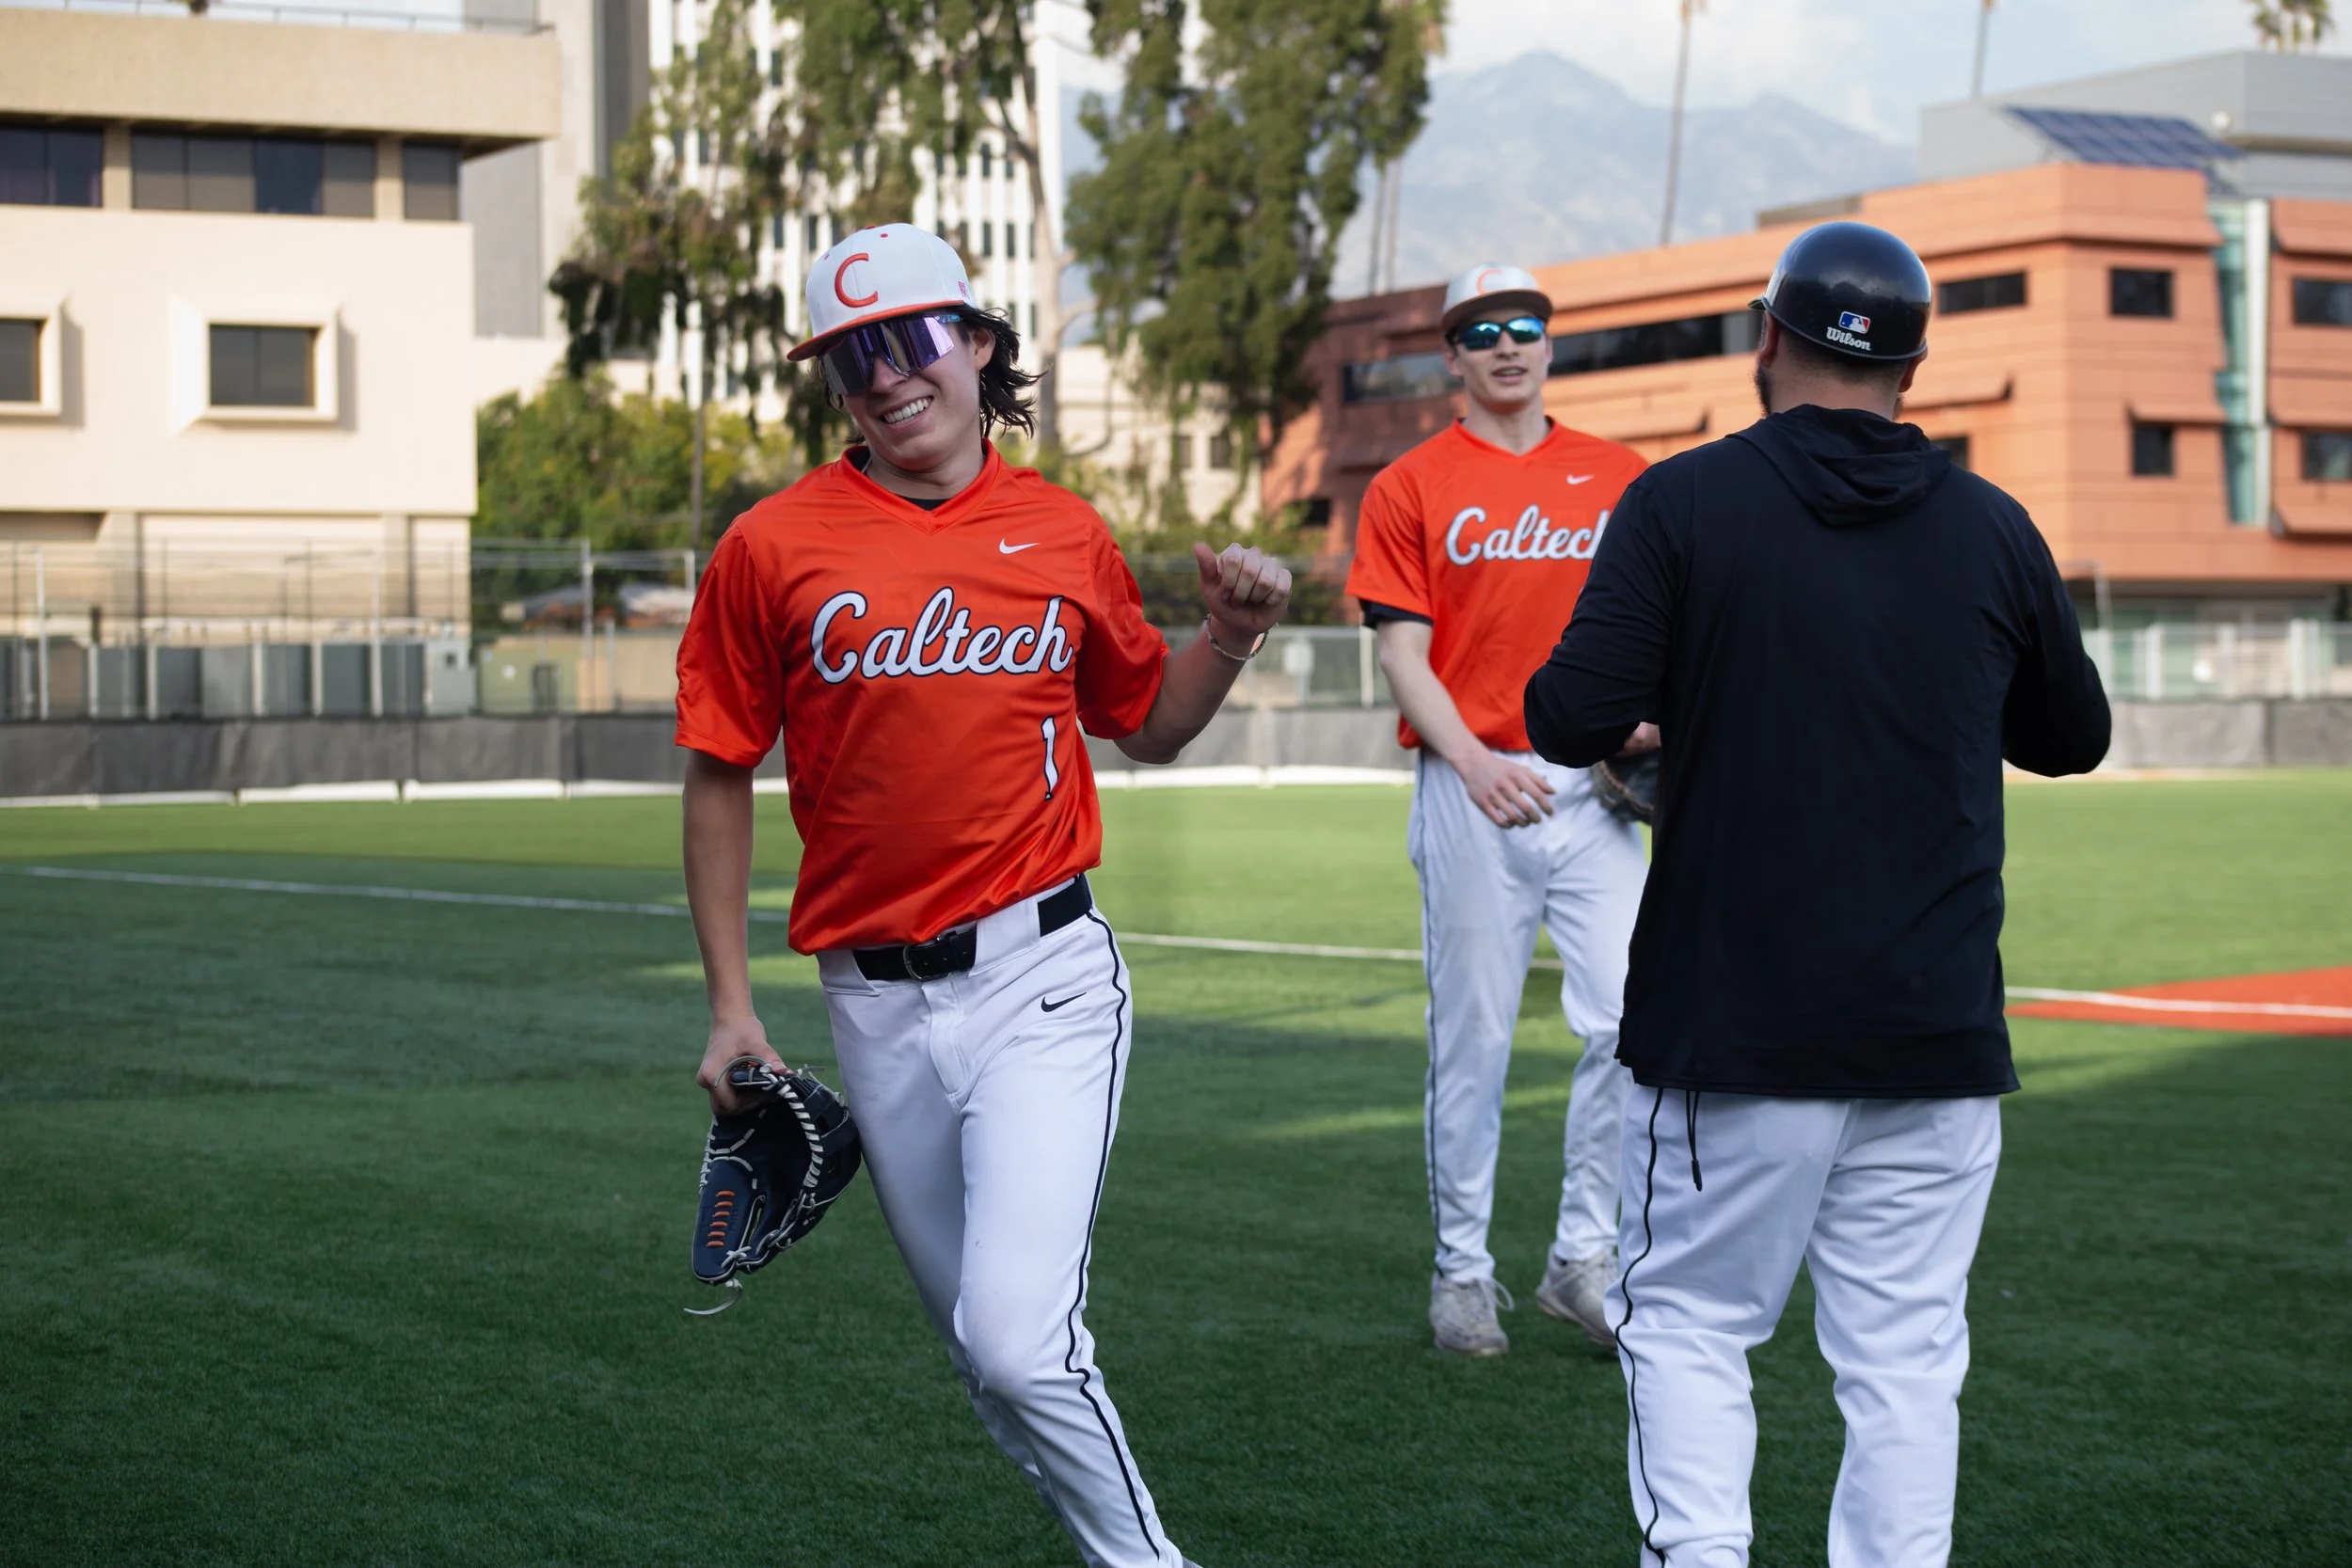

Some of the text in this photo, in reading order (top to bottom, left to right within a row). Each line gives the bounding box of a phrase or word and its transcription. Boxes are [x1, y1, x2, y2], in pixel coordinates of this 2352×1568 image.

[834, 252, 878, 308] C
[1826, 326, 1871, 351] Wilson
[811, 586, 1073, 684] Caltech
[1041, 716, 1059, 800] 1
